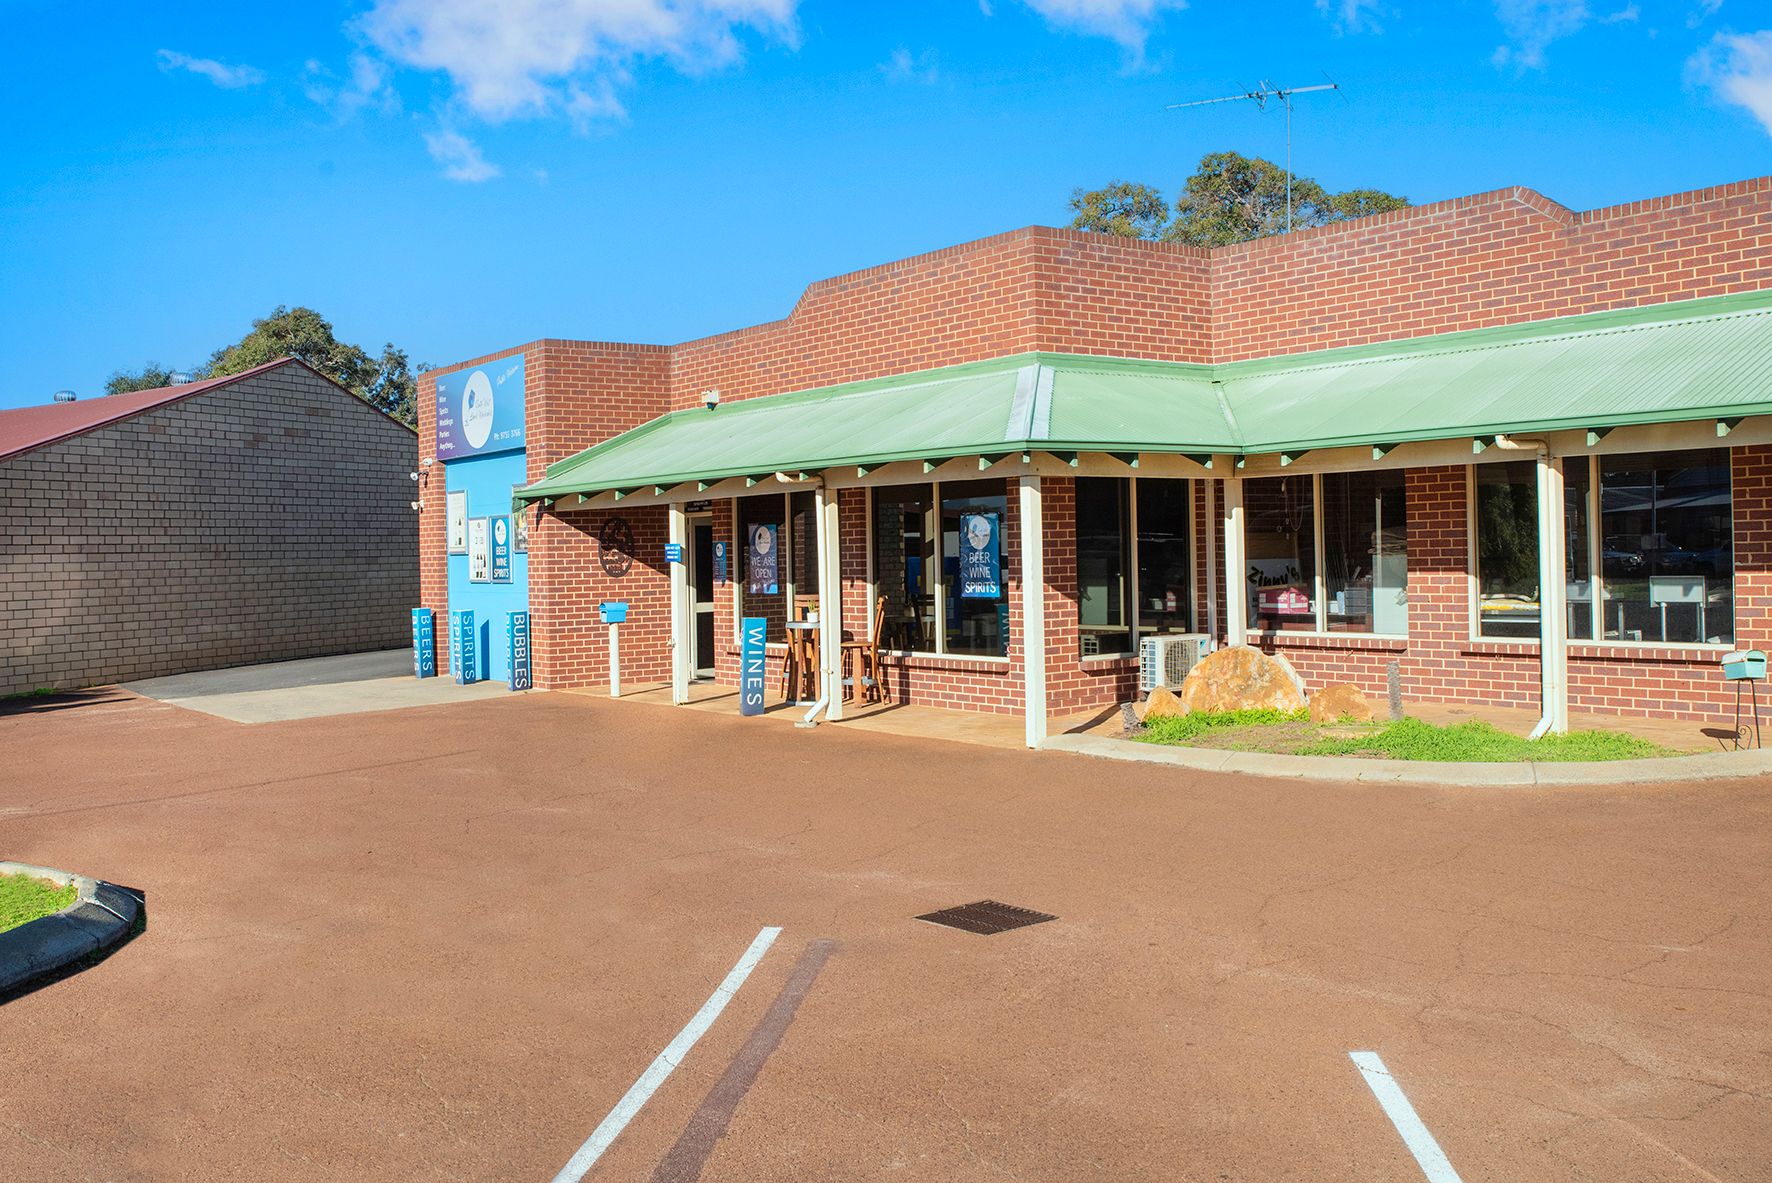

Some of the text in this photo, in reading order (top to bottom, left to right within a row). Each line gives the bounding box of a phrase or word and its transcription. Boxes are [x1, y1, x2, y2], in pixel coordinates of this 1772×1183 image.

[496, 546, 507, 555] BEER
[496, 557, 508, 566] WINE
[751, 556, 776, 567] WE ARE
[969, 551, 991, 564] BEER
[493, 568, 510, 578] SPIRITS
[755, 568, 772, 579] OPEN
[969, 566, 992, 578] WINE
[965, 581, 997, 593] SPIRITS
[420, 615, 432, 671] BEERS
[463, 615, 475, 680] SPIRITS
[513, 614, 528, 689] BUBBLES
[746, 627, 764, 706] WINES
